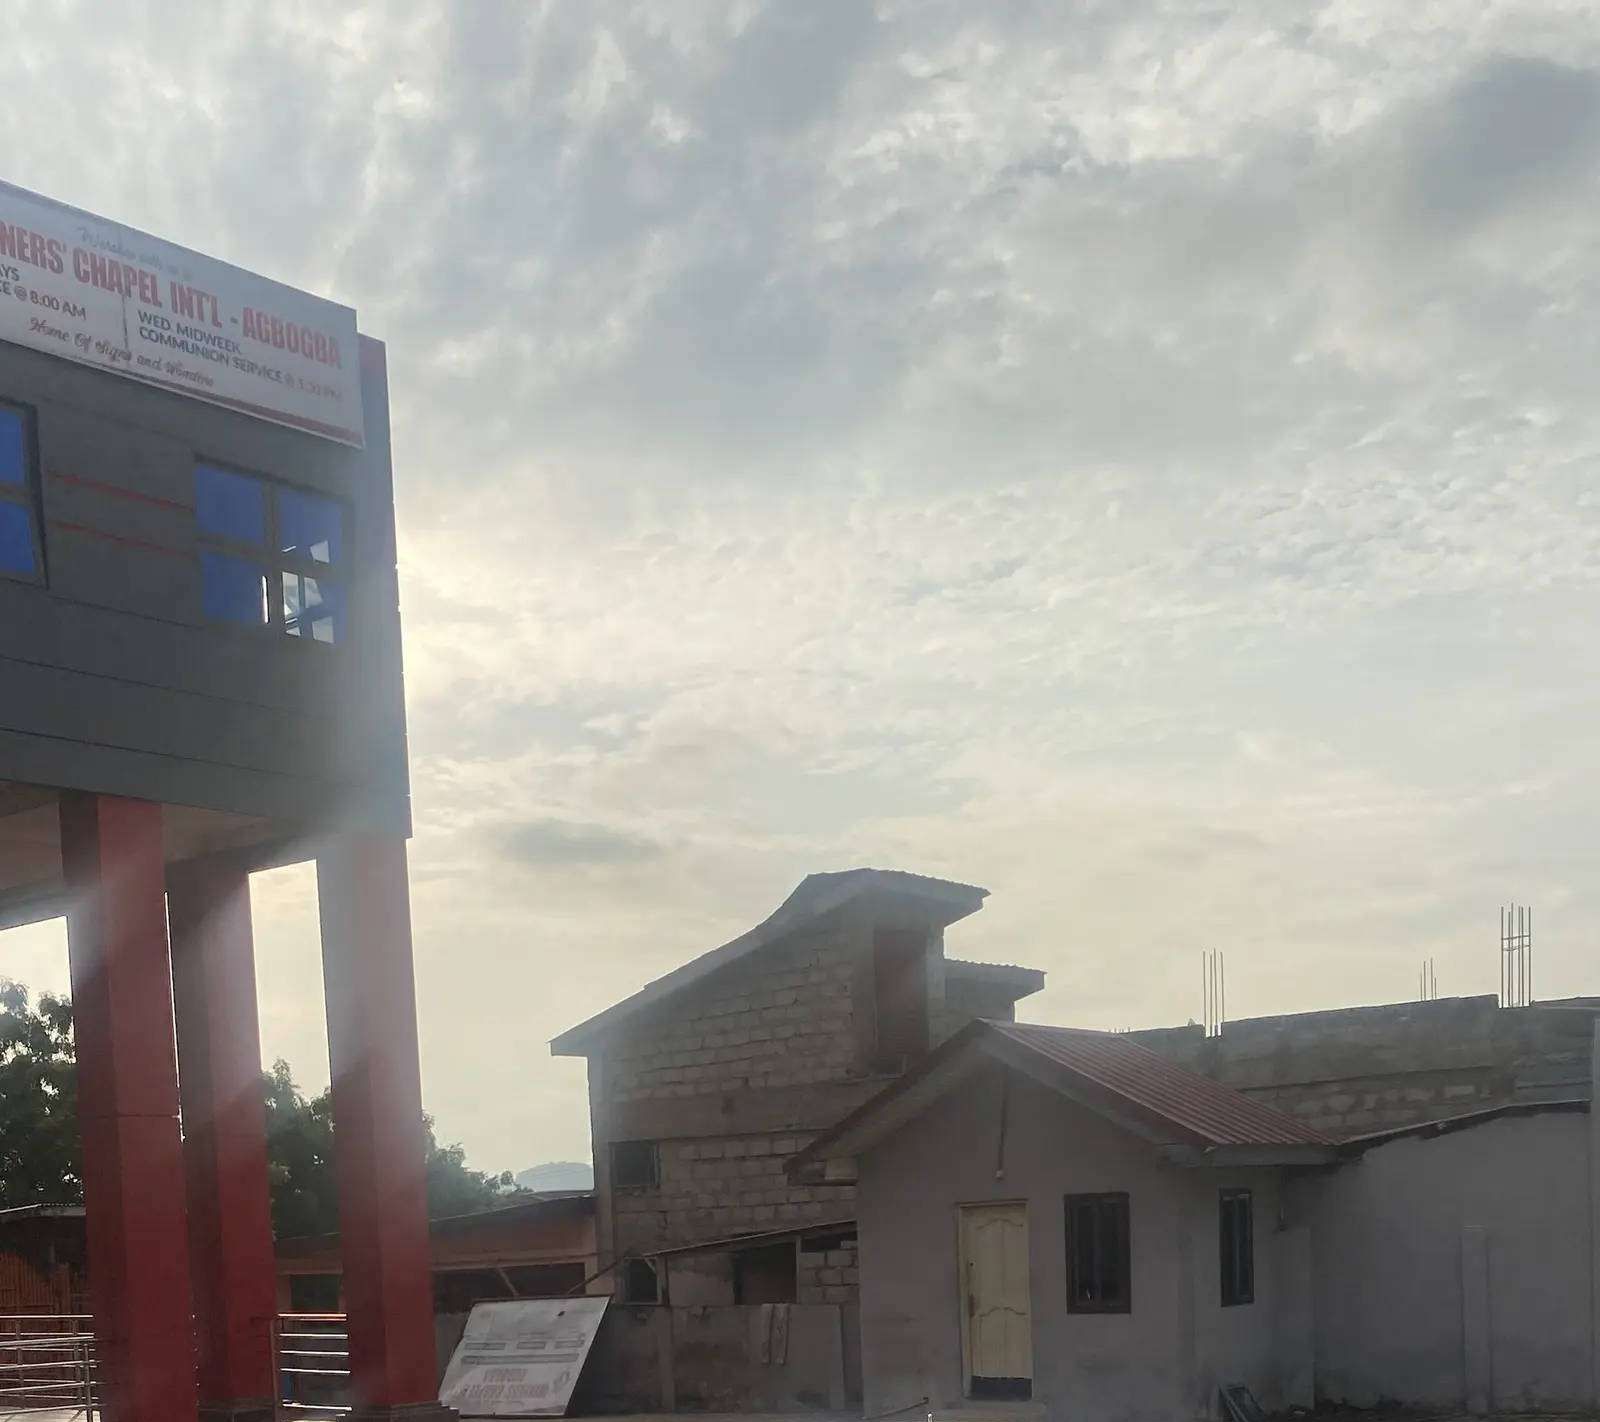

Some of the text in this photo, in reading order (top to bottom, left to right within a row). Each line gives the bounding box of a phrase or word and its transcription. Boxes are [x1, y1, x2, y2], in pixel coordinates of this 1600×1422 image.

[62, 301, 86, 321] AM
[73, 247, 163, 308] CHAPEL
[170, 281, 223, 329] INT'L
[243, 306, 343, 370] AGBOGBA
[138, 325, 230, 367] COMMUNION
[232, 355, 284, 385] SERVICE
[176, 322, 244, 356] MIDWEEK
